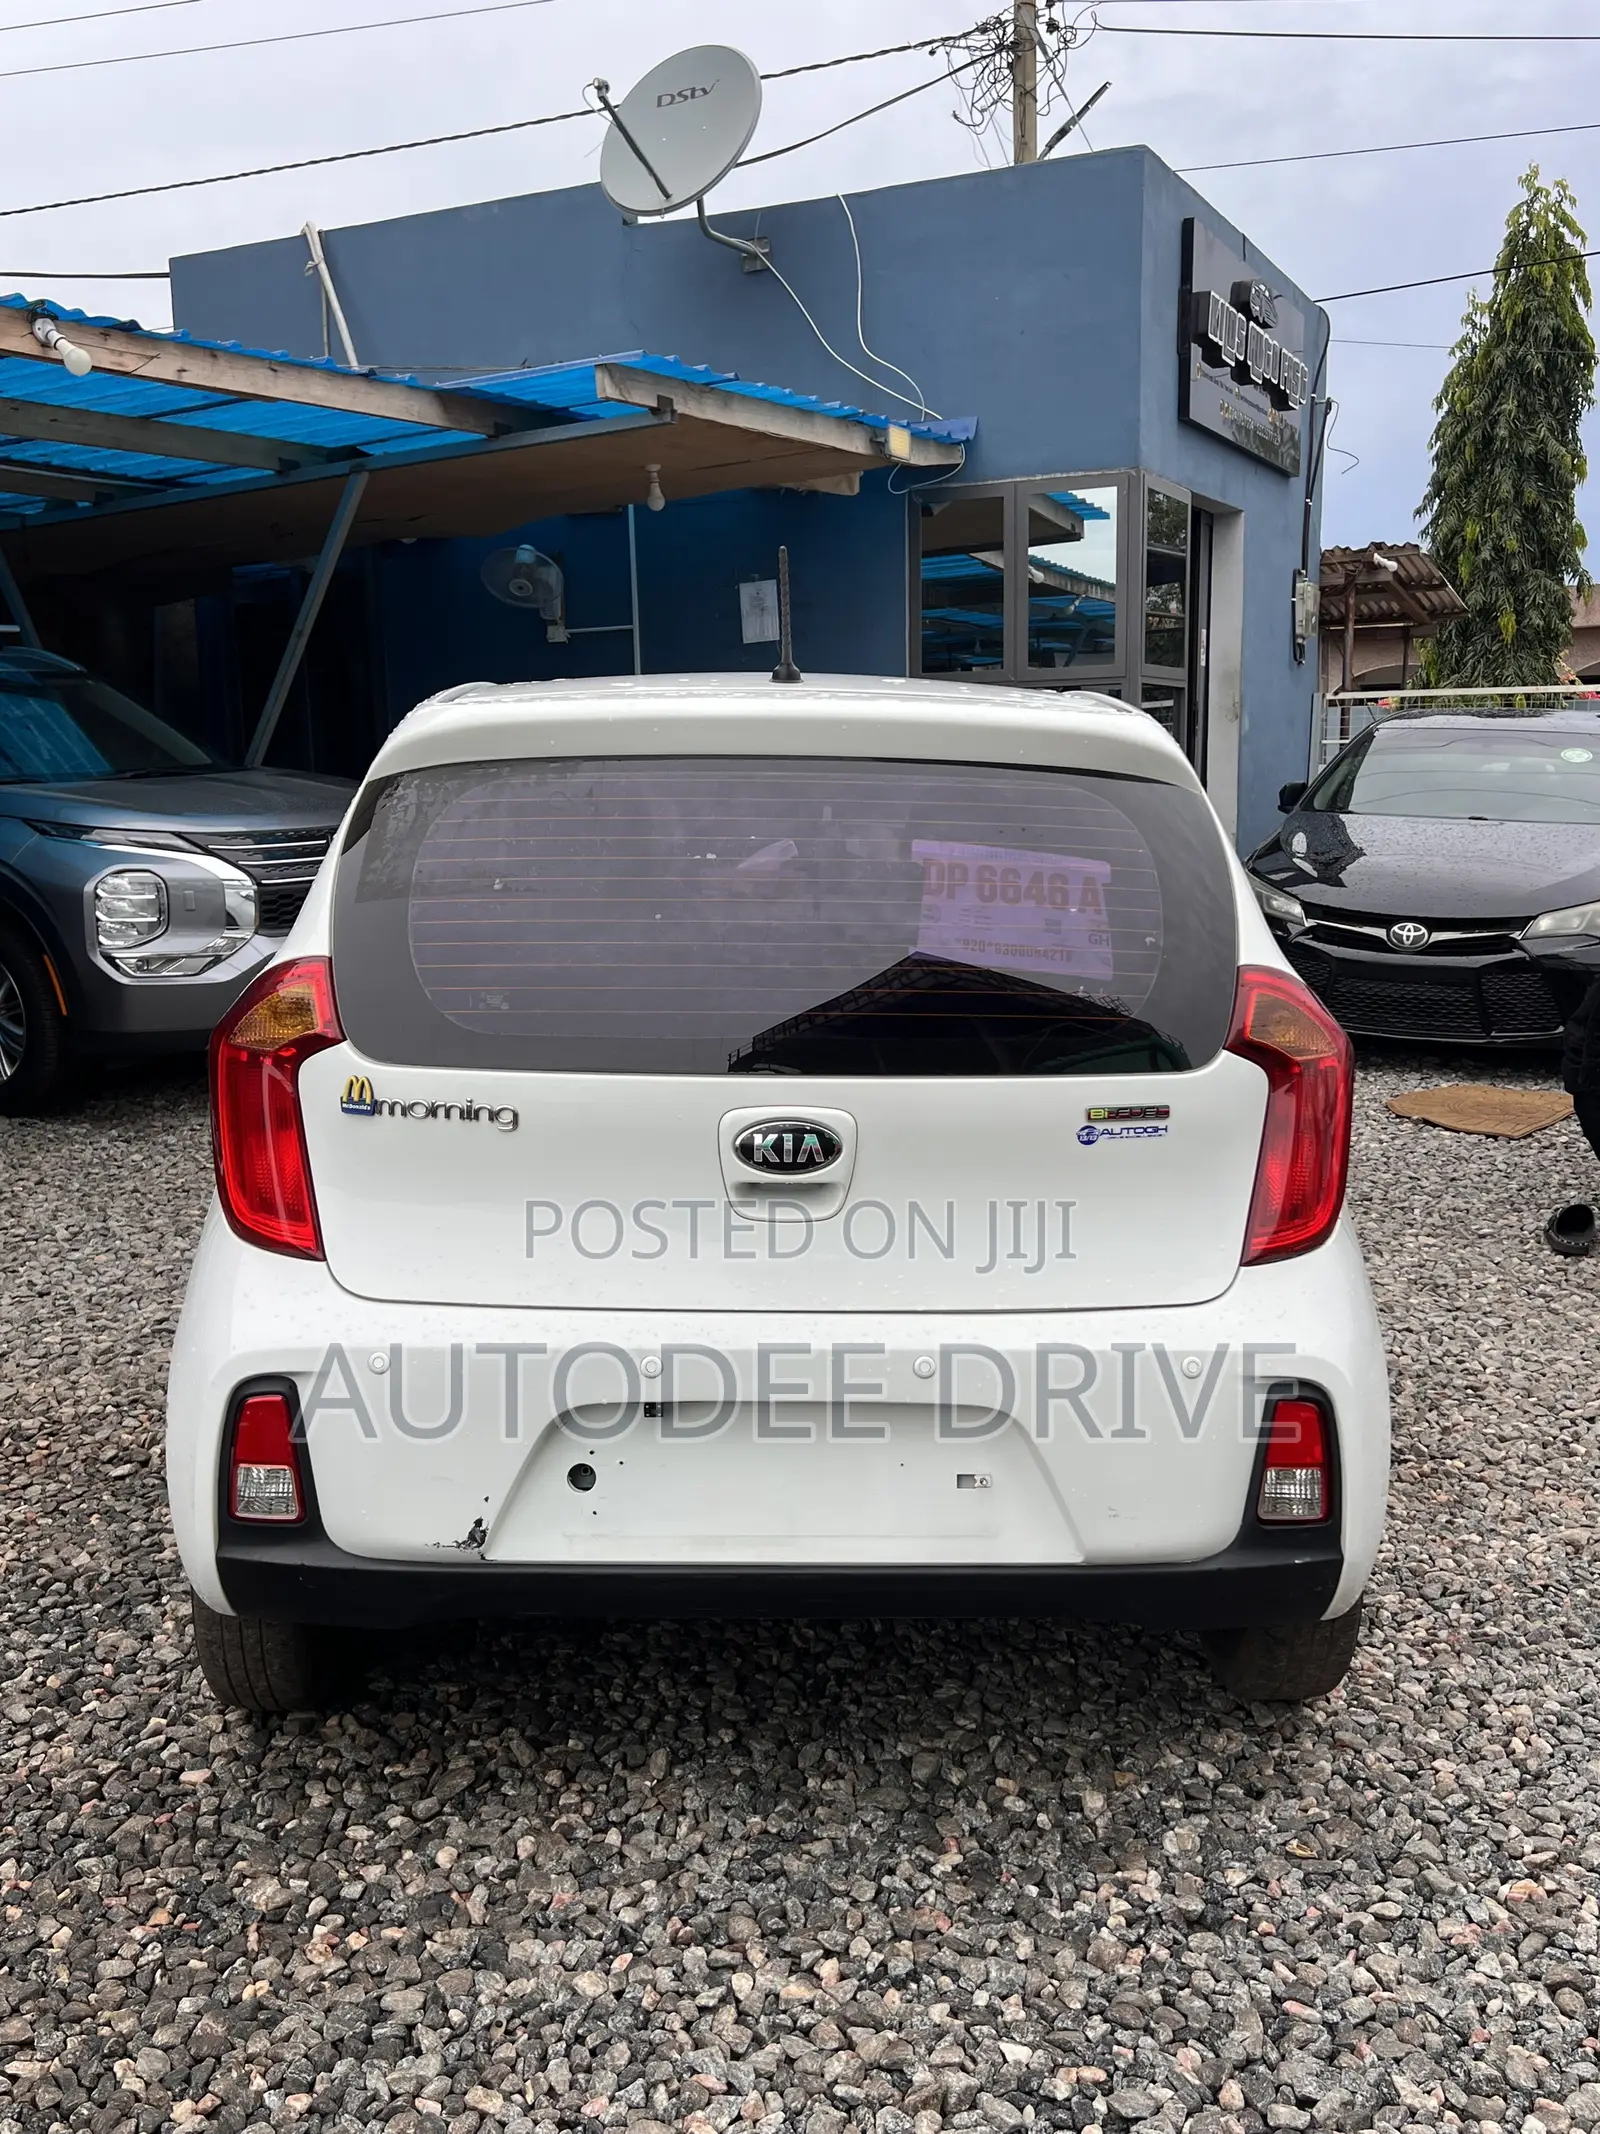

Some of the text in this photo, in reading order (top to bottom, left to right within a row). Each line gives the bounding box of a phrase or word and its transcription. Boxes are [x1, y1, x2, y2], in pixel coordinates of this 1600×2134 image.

[656, 82, 717, 108] DStv
[922, 857, 969, 900] DP
[975, 864, 1070, 911] 6646
[1078, 876, 1103, 916] A
[1088, 933, 1110, 948] GH
[375, 1098, 520, 1132] morning
[753, 1133, 825, 1163] KIA
